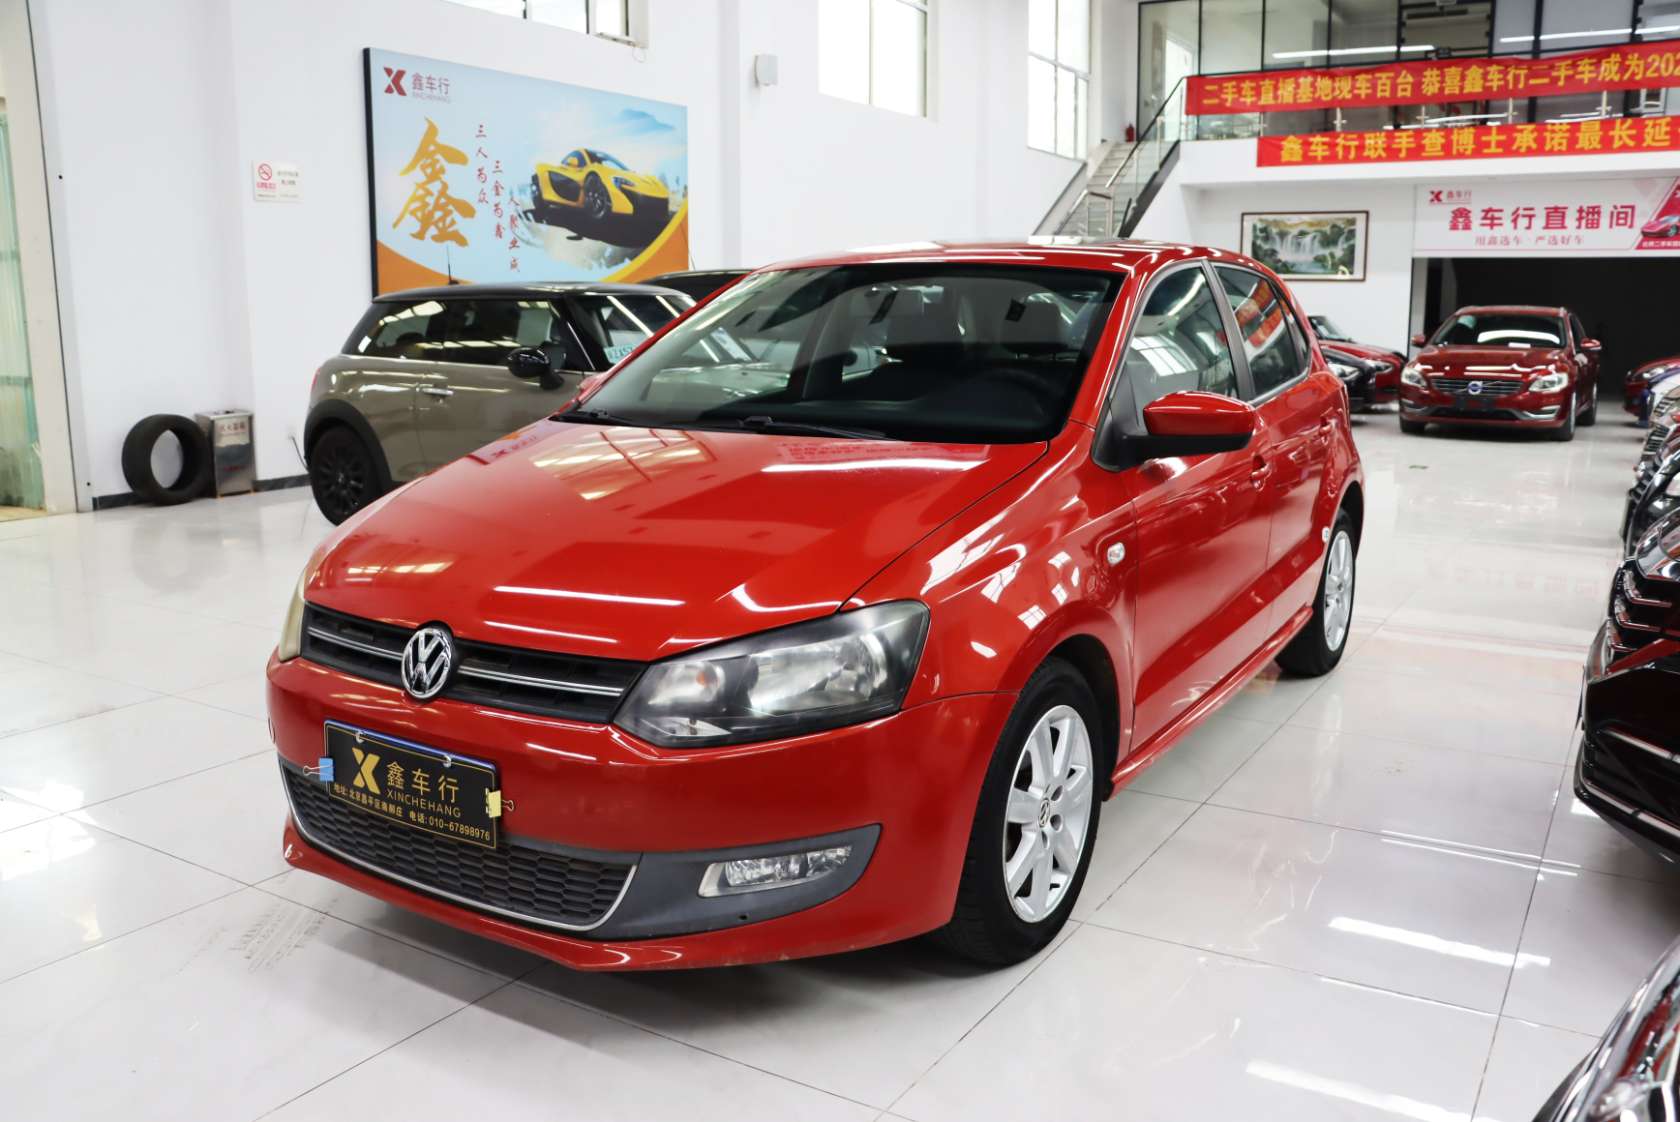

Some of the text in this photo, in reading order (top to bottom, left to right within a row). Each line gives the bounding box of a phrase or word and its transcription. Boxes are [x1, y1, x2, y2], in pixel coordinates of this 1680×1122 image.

[1202, 70, 1414, 107] 二手车直播基地现车百台
[1280, 117, 1680, 162] 鑫车行联手查博士承诺最长延
[1449, 204, 1636, 231] 鑫车行直播间
[386, 761, 460, 804] 鑫车行
[386, 789, 462, 818] XINCHEHANG
